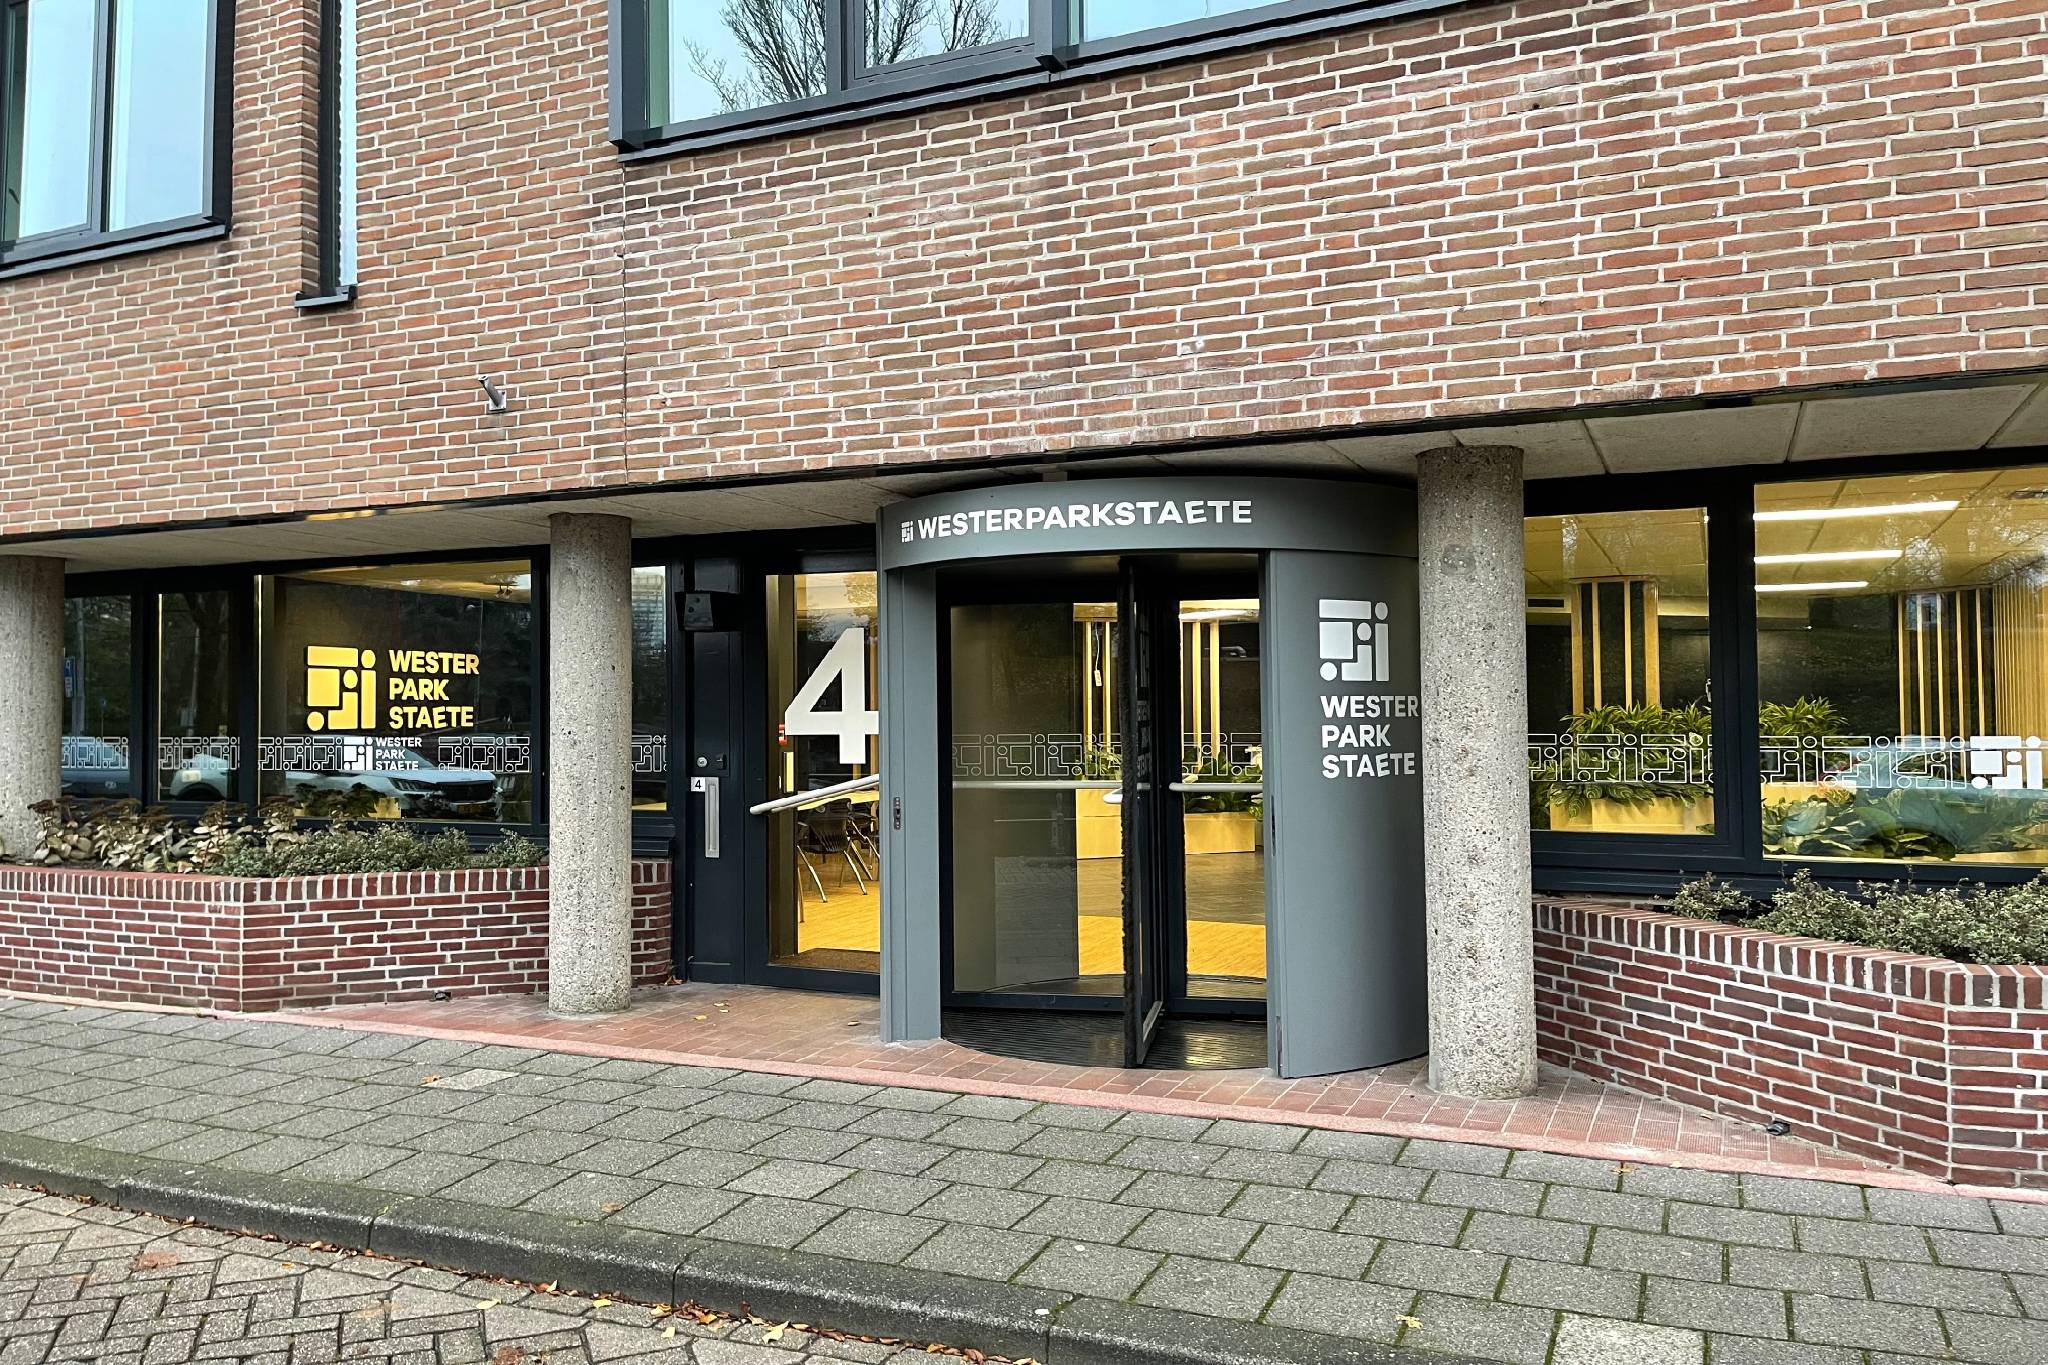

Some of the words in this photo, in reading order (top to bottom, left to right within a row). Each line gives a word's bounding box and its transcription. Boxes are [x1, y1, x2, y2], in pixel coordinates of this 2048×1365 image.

[918, 500, 1252, 540] WESTERPARKSTAETE
[388, 649, 480, 675] WESTER
[389, 677, 450, 701] PARK
[784, 627, 879, 764] 4
[388, 705, 474, 729] STAETE
[1320, 695, 1420, 718] WESTER
[375, 737, 423, 748] WESTER
[1321, 723, 1391, 748] PARK
[375, 748, 406, 760] PARK
[375, 760, 419, 771] STAETE
[1322, 752, 1416, 779] STAETE
[694, 779, 702, 790] 4
